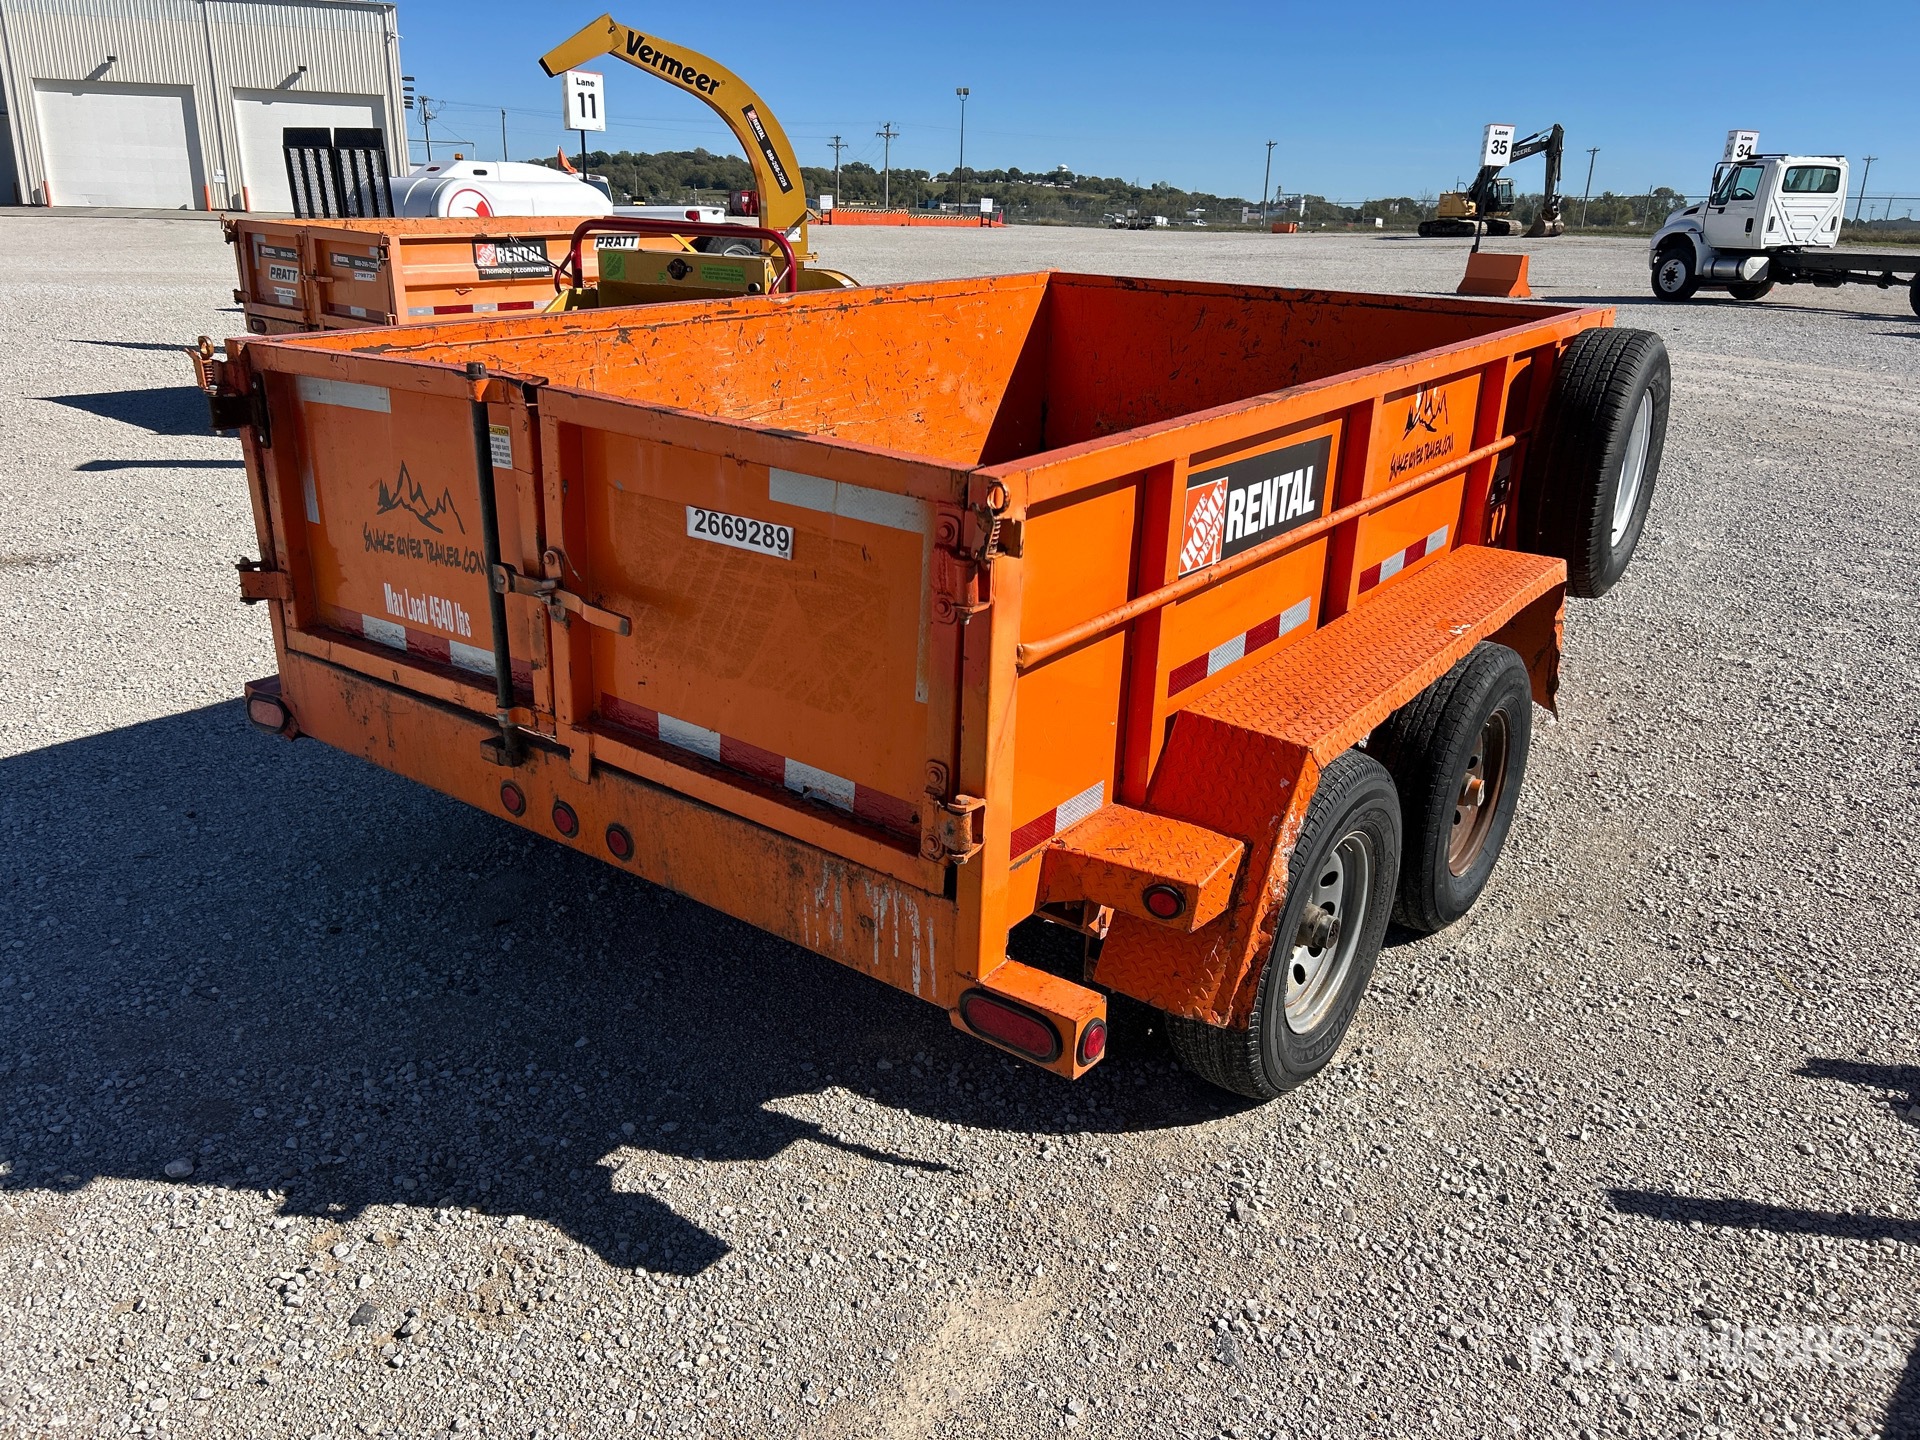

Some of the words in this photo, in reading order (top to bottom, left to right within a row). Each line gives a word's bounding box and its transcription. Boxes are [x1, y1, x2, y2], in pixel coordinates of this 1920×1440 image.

[626, 30, 720, 95] Vermeer
[576, 77, 595, 88] Lane
[577, 92, 597, 119] 11
[753, 118, 766, 140] RENTAL
[1491, 139, 1508, 155] 35
[1512, 147, 1532, 157] DEERE
[1737, 144, 1752, 158] 34
[596, 235, 638, 248] PRATT
[496, 246, 546, 263] RENTAL
[270, 267, 298, 281] PRATT
[1188, 493, 1208, 529] THE
[1225, 465, 1316, 544] RENTAL
[694, 509, 790, 552] 2669289
[1181, 480, 1227, 570] HOME
[363, 522, 395, 553] SNAKE
[396, 532, 424, 560] RIVER
[384, 583, 406, 618] Max
[405, 588, 428, 625] Load
[429, 595, 455, 632] 4540
[454, 602, 472, 638] lbs
